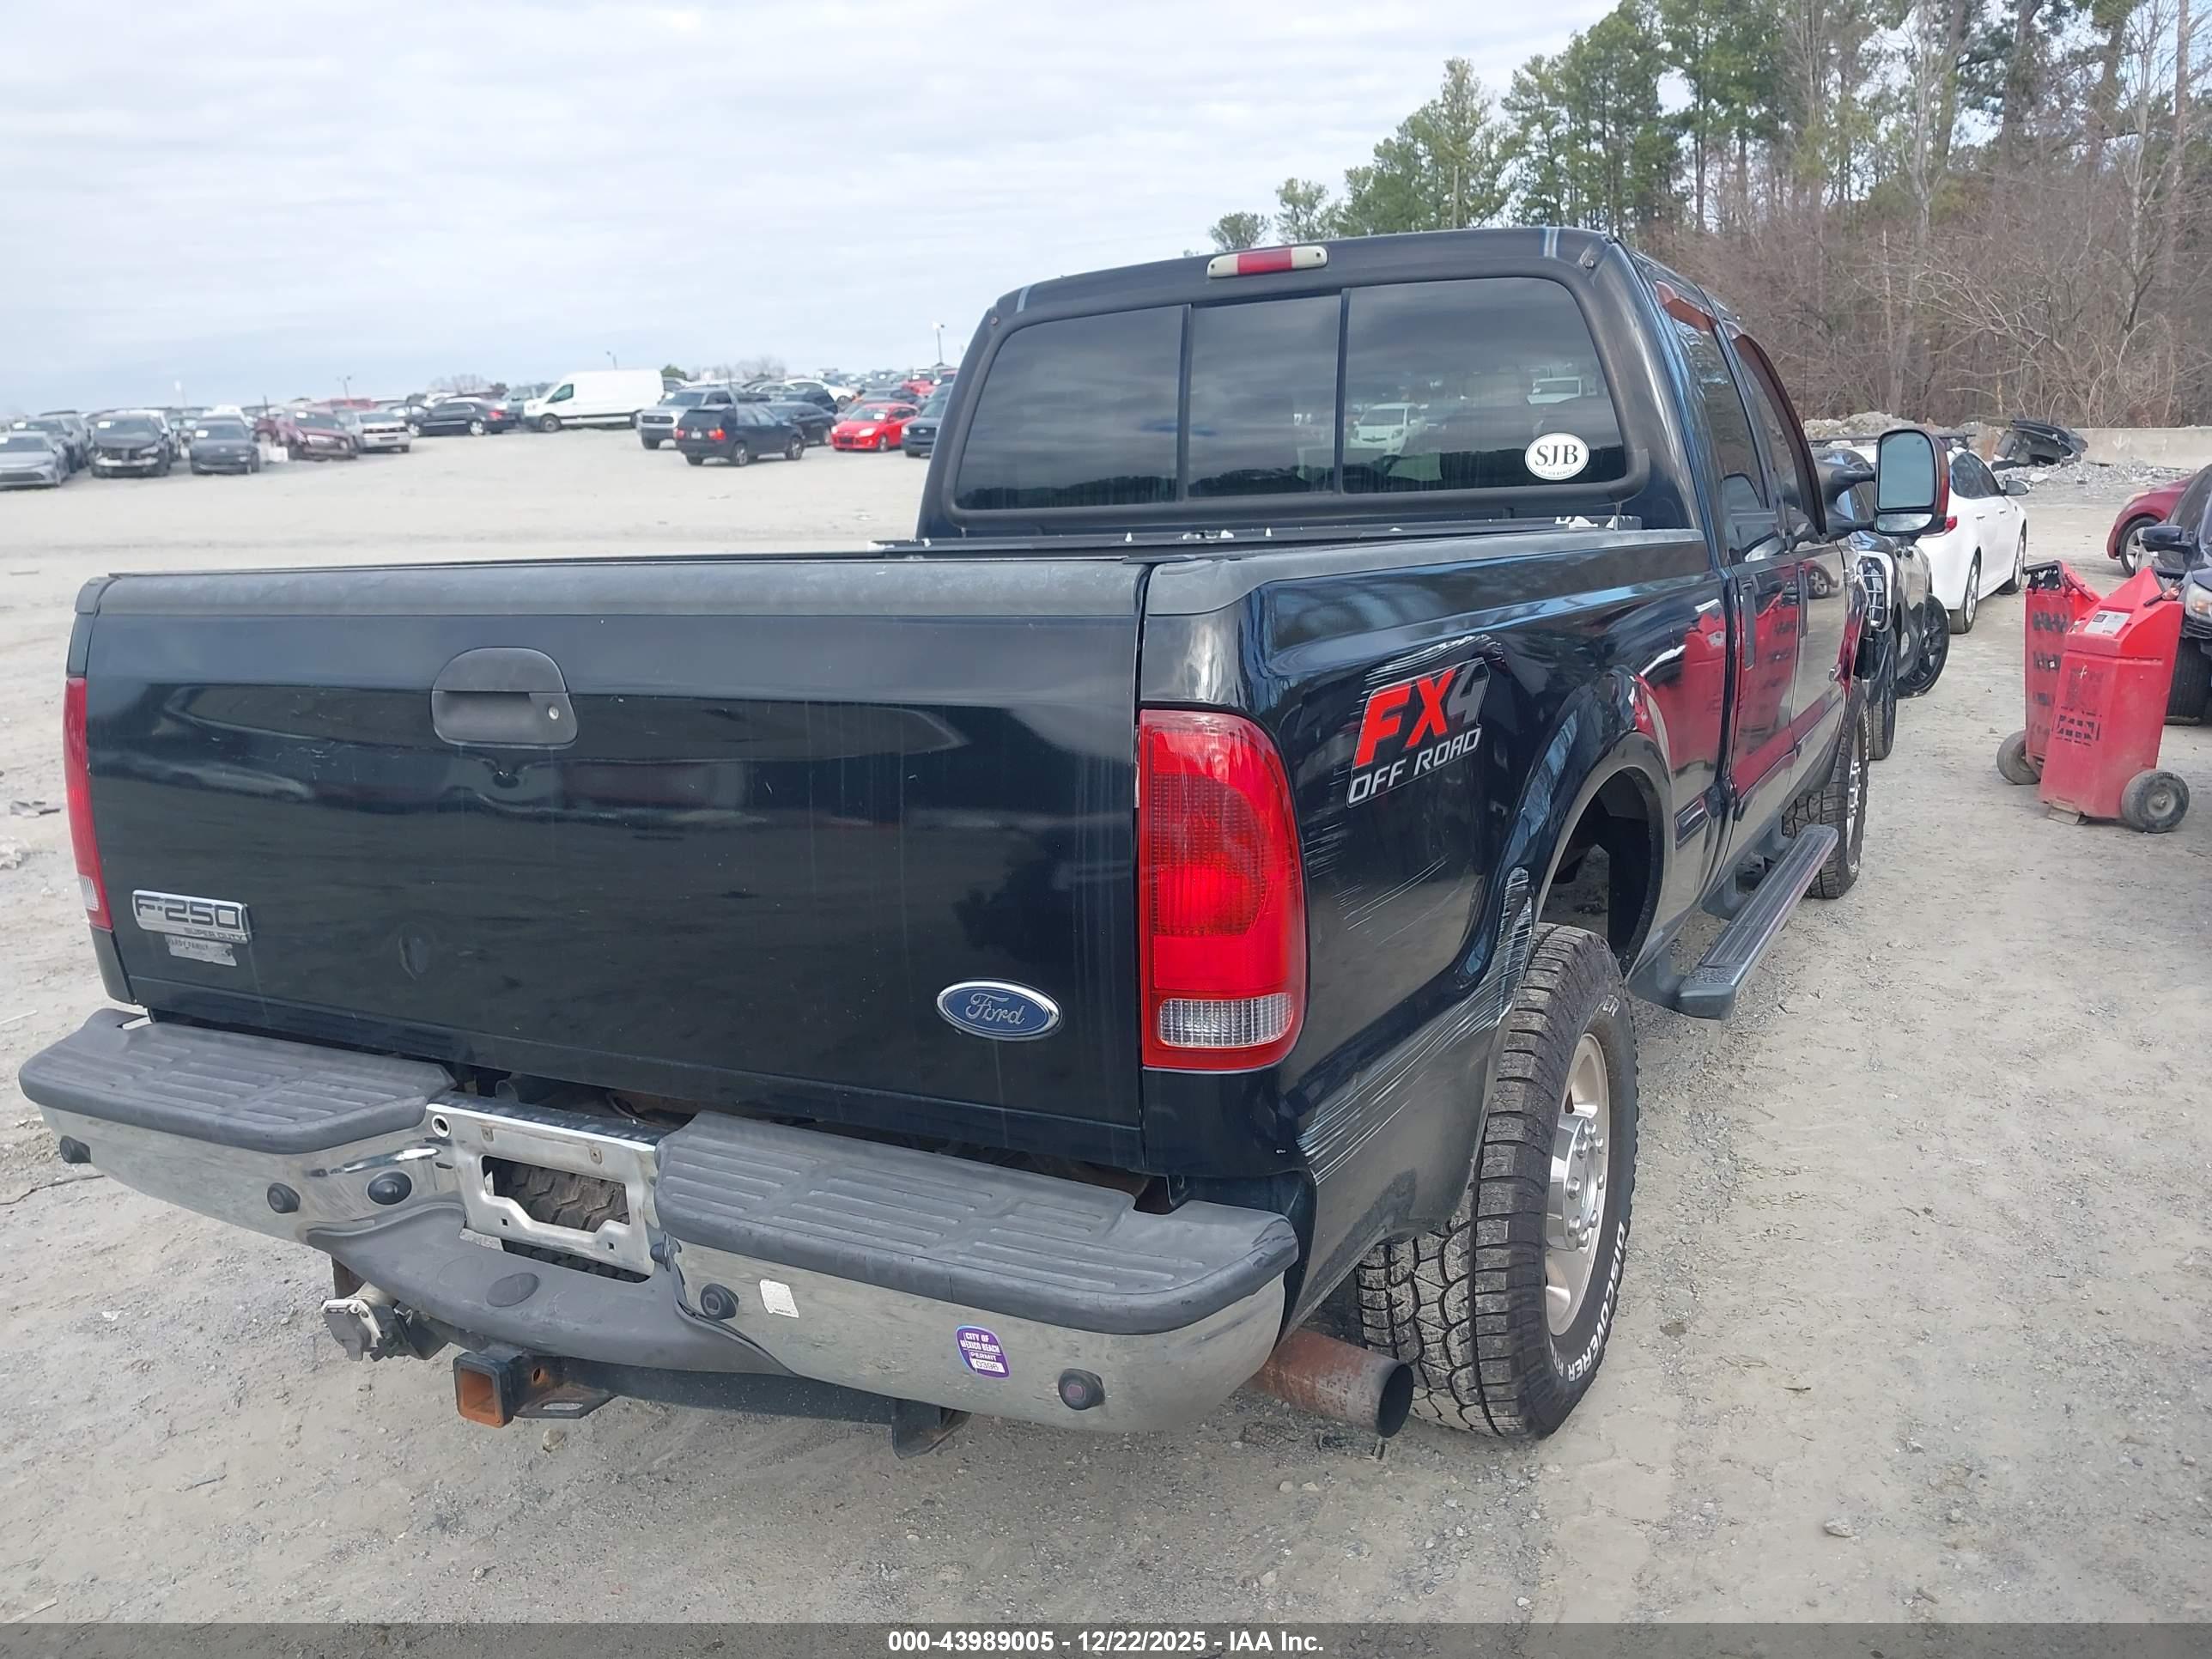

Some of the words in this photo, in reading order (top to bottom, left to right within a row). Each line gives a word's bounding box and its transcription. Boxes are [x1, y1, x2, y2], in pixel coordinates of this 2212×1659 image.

[1534, 444, 1578, 466] SJB
[1353, 661, 1487, 768] FX4
[1348, 757, 1407, 805] OFF
[1413, 727, 1481, 775] ROAD
[965, 993, 1025, 1025] Ford
[1567, 1220, 1626, 1382] DISCOVERER
[965, 1332, 979, 1341] CITY
[981, 1334, 989, 1343] OF
[970, 1352, 997, 1361] PERMIT
